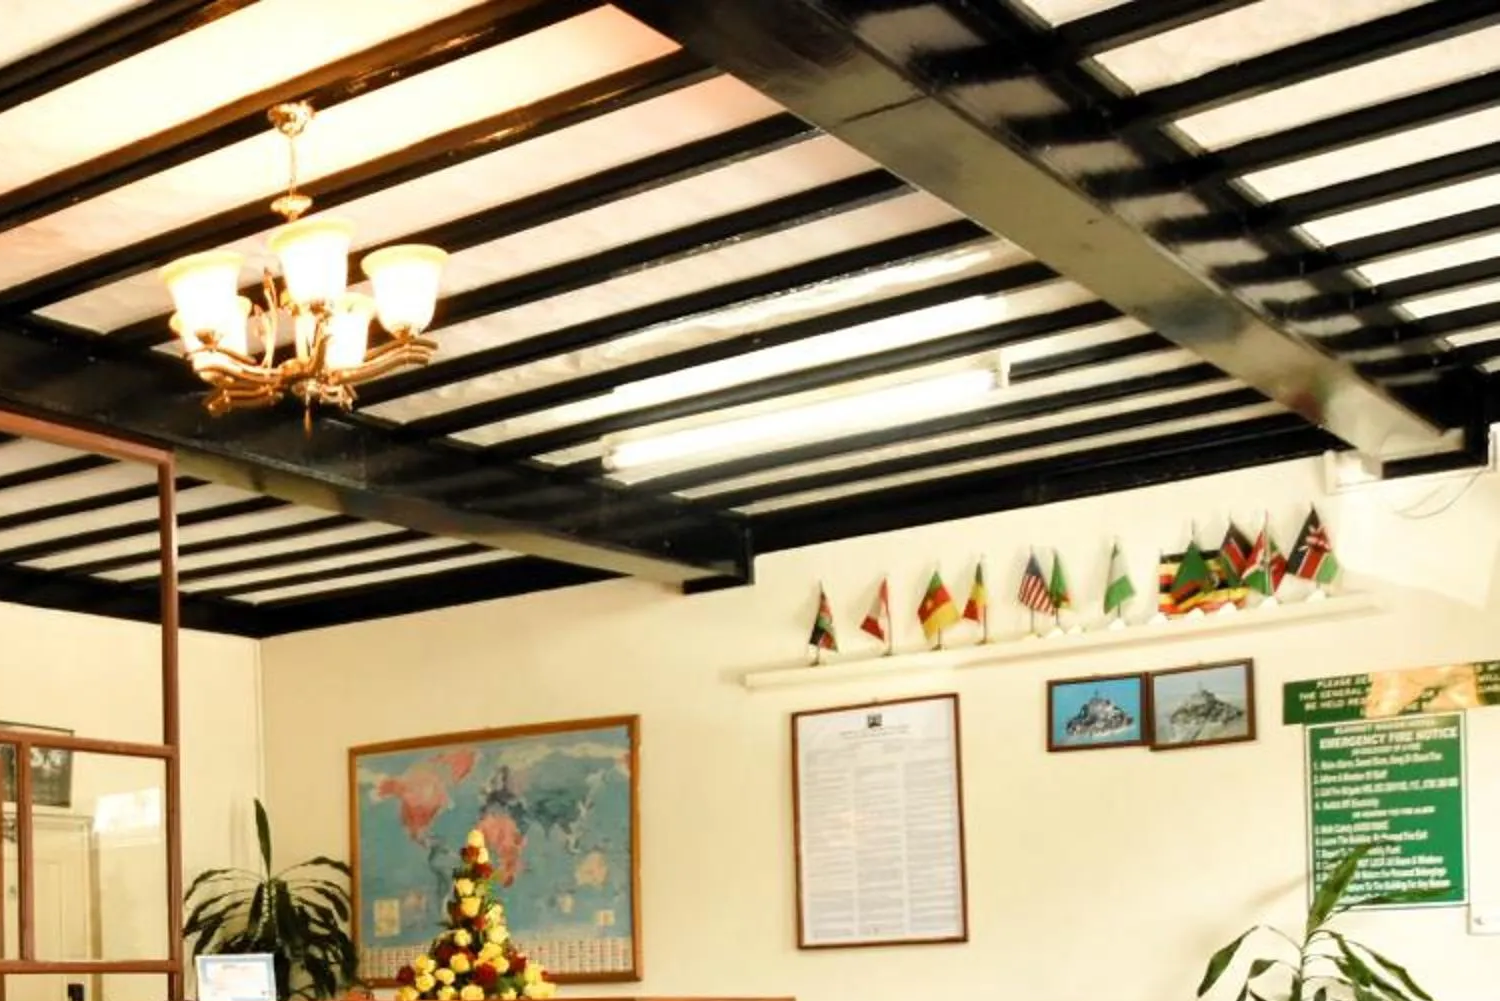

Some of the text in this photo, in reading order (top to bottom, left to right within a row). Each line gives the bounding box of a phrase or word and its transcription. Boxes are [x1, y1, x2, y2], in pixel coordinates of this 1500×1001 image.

[1319, 687, 1364, 699] GENERAL
[1319, 731, 1386, 750] EMERGENCY
[1388, 729, 1413, 743] FIRE
[1415, 726, 1457, 741] NOTICE
